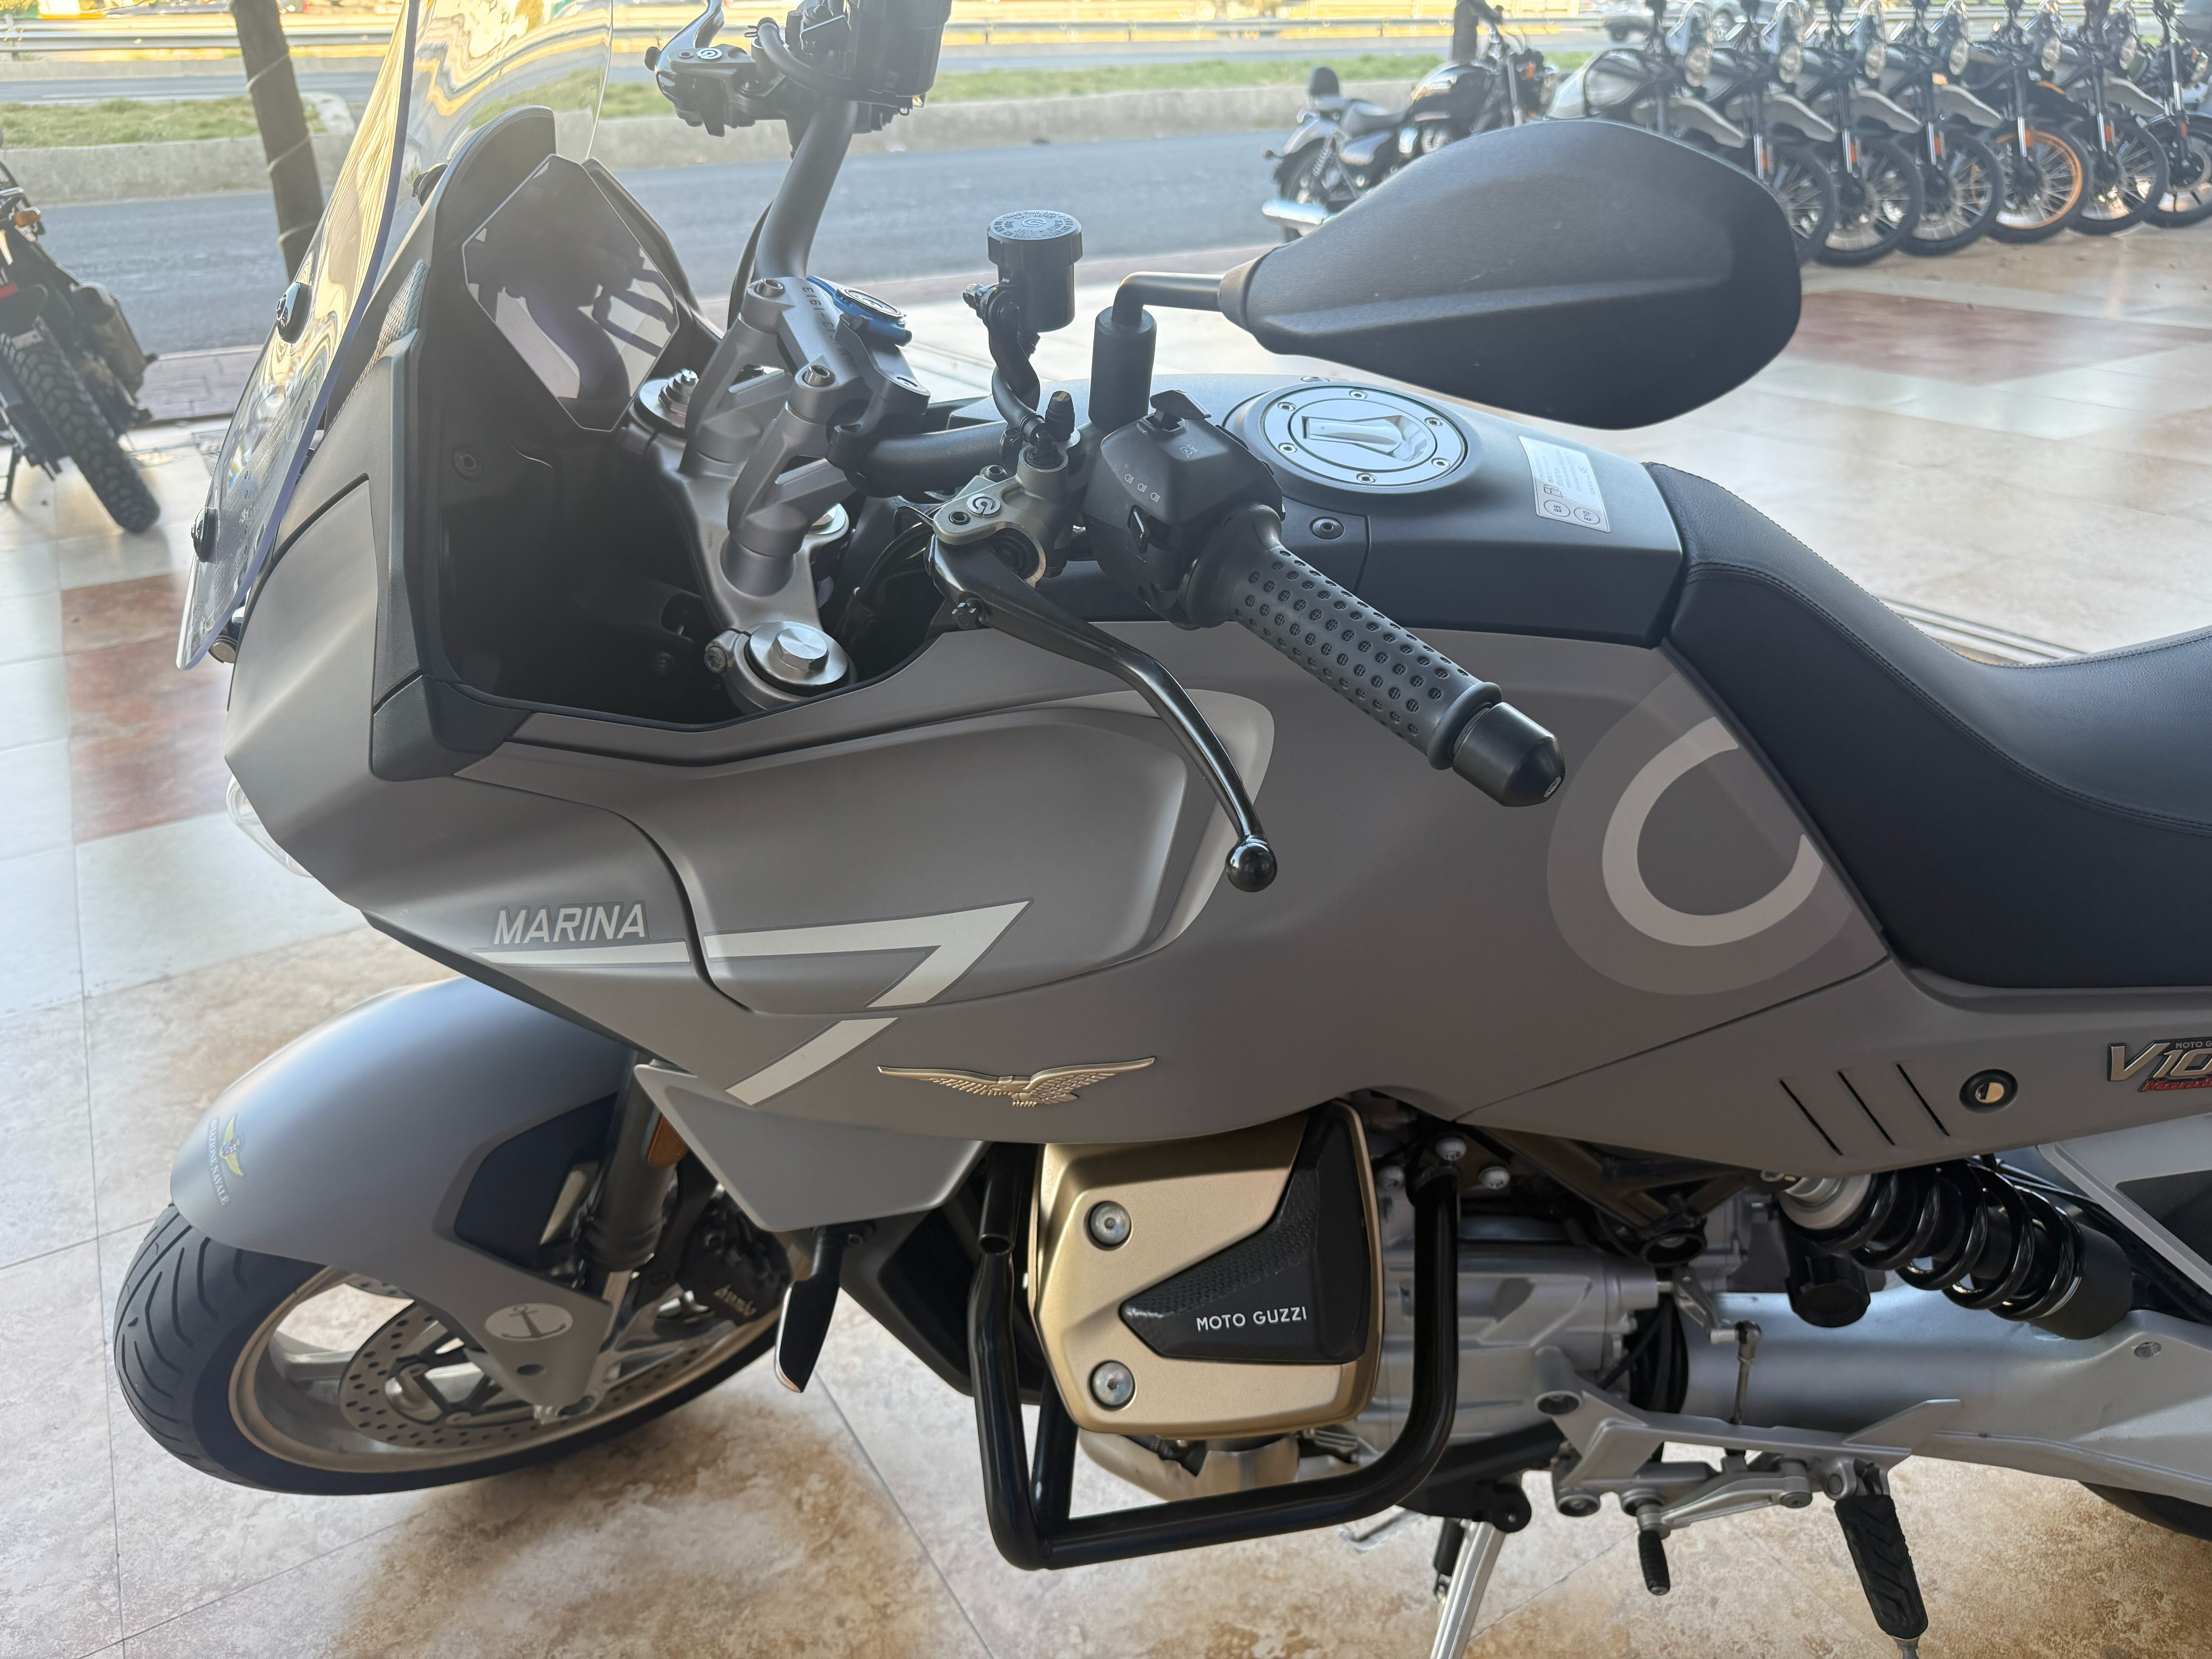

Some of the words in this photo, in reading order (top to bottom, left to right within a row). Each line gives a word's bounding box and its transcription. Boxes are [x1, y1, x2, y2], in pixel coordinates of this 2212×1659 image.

[1583, 511, 1591, 521] E10
[494, 904, 646, 945] MARINA
[211, 1165, 230, 1206] NAVALE
[1196, 1313, 1246, 1331] MOTO
[1253, 1306, 1307, 1324] GUZZI
